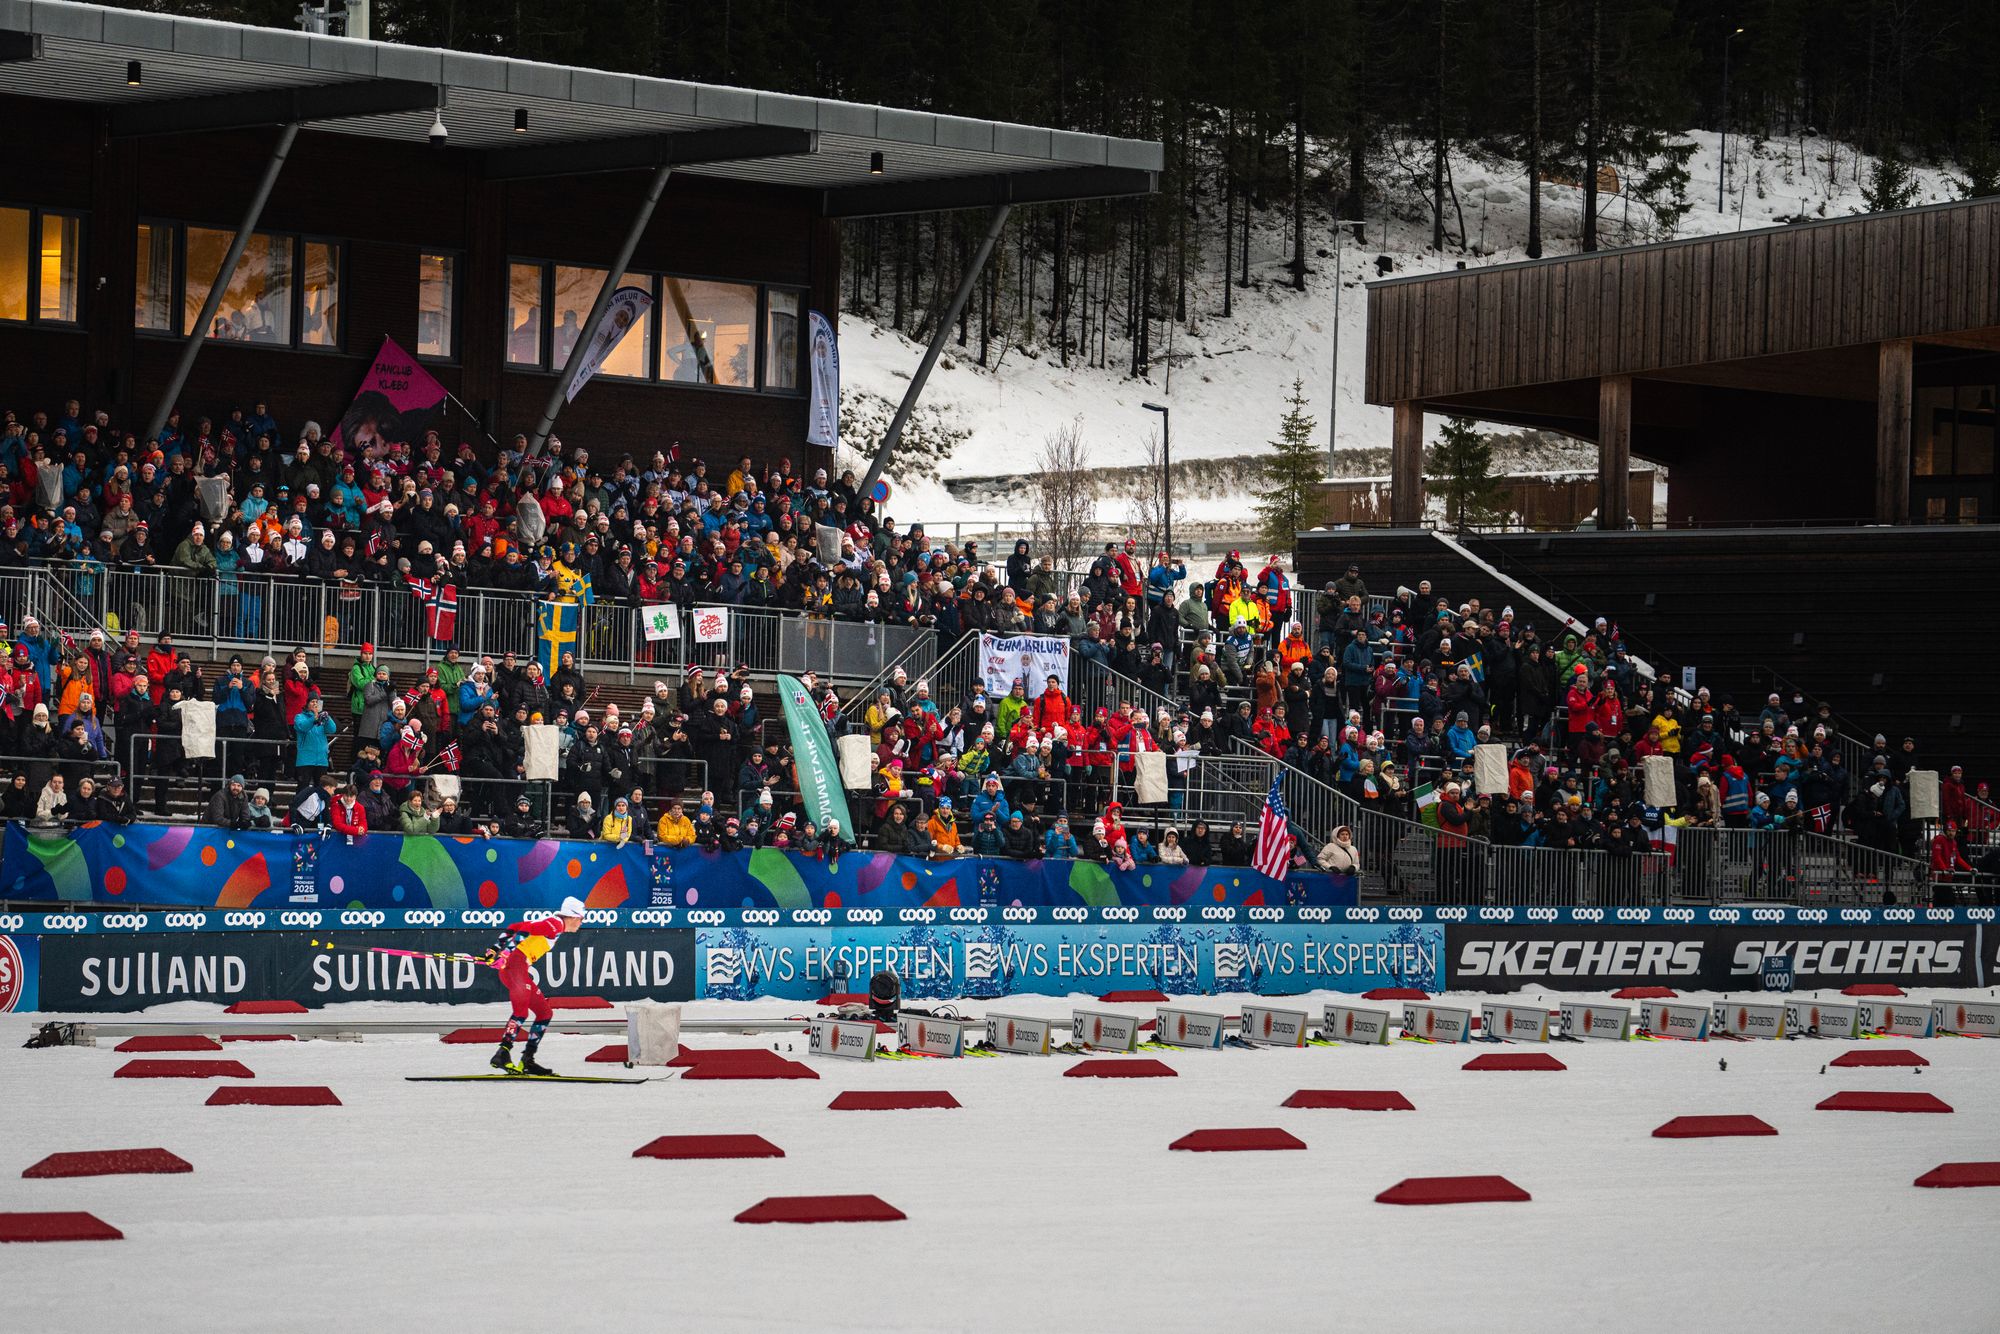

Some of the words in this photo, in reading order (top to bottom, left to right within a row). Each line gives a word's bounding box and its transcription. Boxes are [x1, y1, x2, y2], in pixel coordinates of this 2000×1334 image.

[375, 363, 413, 376] FANCLUB
[990, 637, 1022, 652] TEAM
[1025, 638, 1062, 655] KALVA
[293, 884, 315, 893] 2025
[651, 896, 673, 904] 2025
[44, 916, 87, 932] coop
[103, 914, 147, 931] coop
[165, 913, 206, 929] coop
[225, 912, 265, 928] coop
[281, 911, 322, 928] coop
[341, 911, 385, 927] coop
[405, 911, 445, 927] coop
[462, 911, 505, 927] coop
[523, 911, 563, 922] coo
[632, 911, 672, 926] coop
[687, 910, 726, 926] coop
[742, 910, 779, 925] coop
[793, 910, 831, 926] coop
[847, 909, 883, 924] coop
[899, 909, 936, 923] coop
[950, 908, 988, 923] coop
[1003, 908, 1037, 923] coop
[1053, 908, 1088, 923] coop
[1102, 908, 1139, 923] coop
[1153, 908, 1186, 922] coop
[1202, 907, 1235, 921] coop
[1249, 908, 1284, 922] coop
[1298, 908, 1331, 922] coop
[1346, 908, 1379, 922] coop
[1389, 908, 1422, 922] coop
[1436, 908, 1467, 922] coop
[1480, 908, 1514, 922] coop
[1527, 908, 1558, 922] coop
[1572, 909, 1604, 922] coop
[1617, 909, 1650, 922] coop
[1664, 909, 1694, 922] coop
[1709, 909, 1740, 923] coop
[1752, 909, 1785, 923] coop
[1797, 910, 1827, 923] coop
[1841, 909, 1871, 923] coop
[1884, 909, 1915, 923] coop
[1927, 909, 1954, 922] coop
[1967, 909, 1995, 922] coop
[741, 947, 794, 982] VVS
[805, 944, 953, 982] EKSPERTEN
[997, 943, 1048, 977] VVS
[1058, 942, 1198, 977] EKSPERTEN
[1244, 942, 1295, 975] VVS
[1304, 941, 1436, 975] EKSPERTEN
[1457, 940, 1704, 976] SKECHERS
[1730, 940, 1964, 975] SKECHERS
[1771, 958, 1784, 968] 50m
[1765, 972, 1789, 991] coop
[1073, 1017, 1083, 1039] 62
[1158, 1015, 1167, 1036] 61
[1242, 1012, 1253, 1033] 60
[1324, 1012, 1335, 1032] 59
[1404, 1011, 1415, 1031] 58
[1482, 1010, 1493, 1031] 57
[1561, 1010, 1572, 1031] 56
[1642, 1008, 1650, 1028] 55
[1713, 1008, 1725, 1028] 54
[1786, 1008, 1798, 1027] 53
[1859, 1008, 1871, 1027] 52
[811, 1026, 821, 1048] 65
[898, 1022, 907, 1043] 64
[987, 1020, 996, 1042] 63
